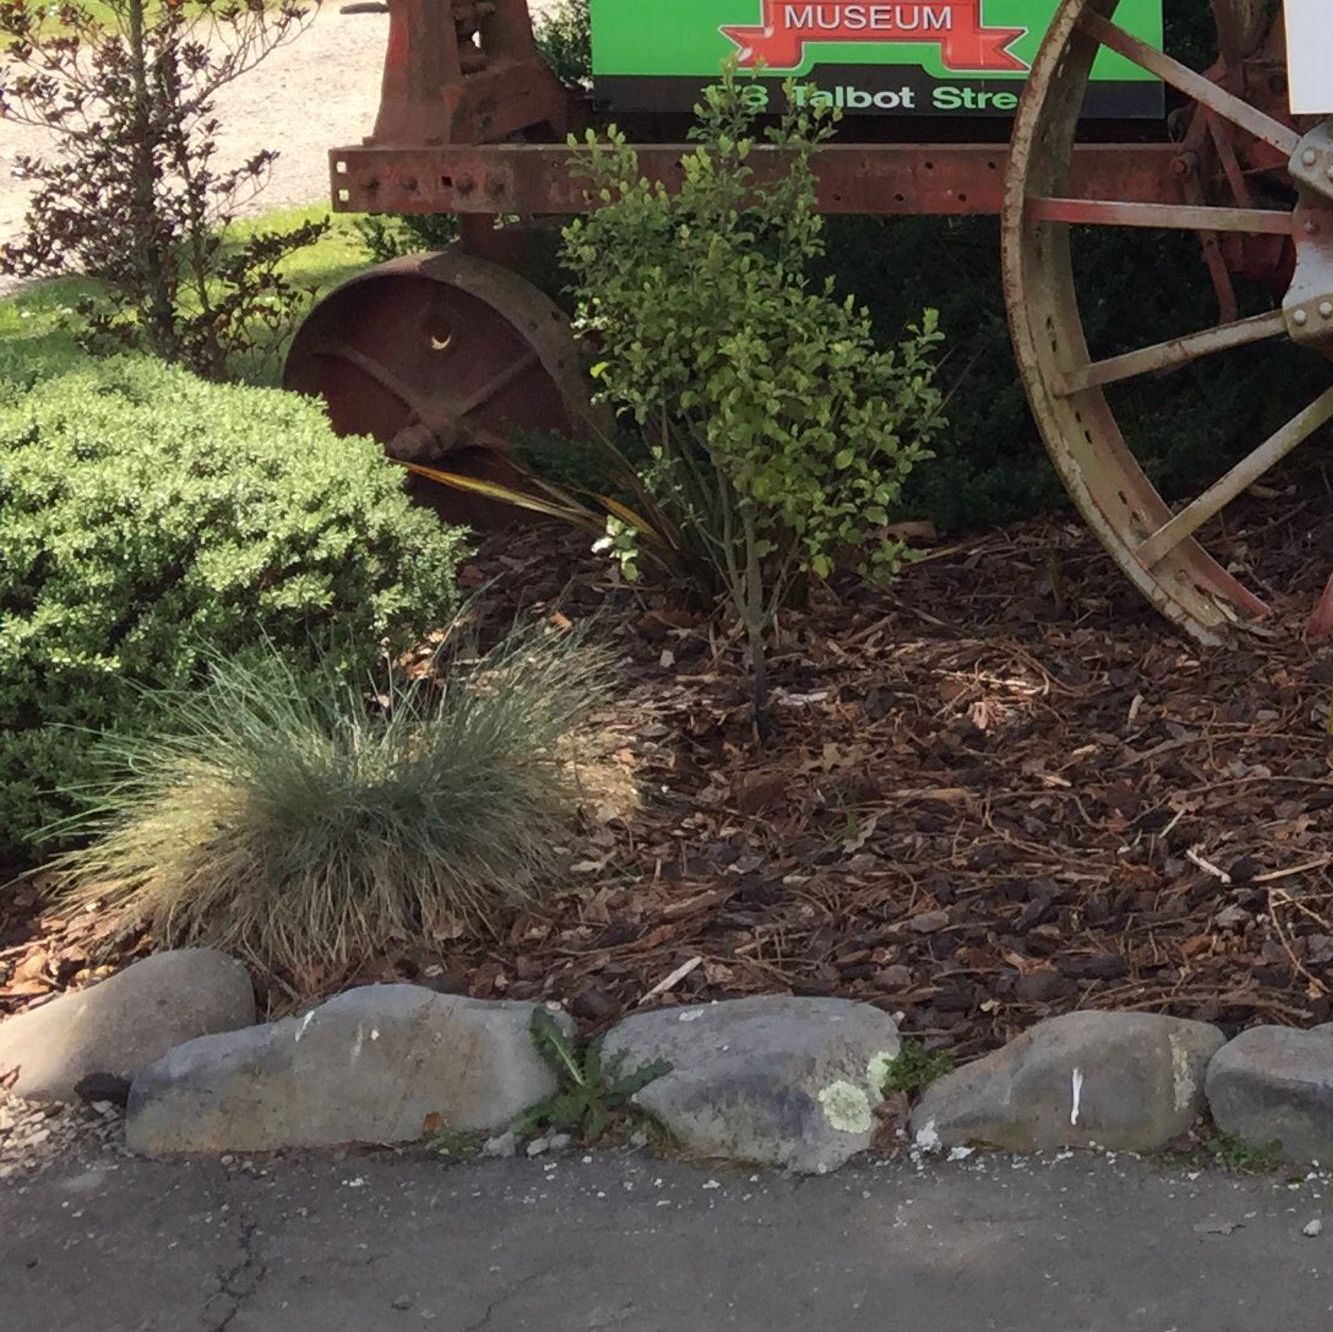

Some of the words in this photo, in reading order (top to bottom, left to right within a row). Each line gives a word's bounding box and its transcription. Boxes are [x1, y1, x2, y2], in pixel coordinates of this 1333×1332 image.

[784, 5, 952, 31] MUSEUM
[788, 85, 915, 109] Talbot
[932, 86, 1018, 110] Stre
